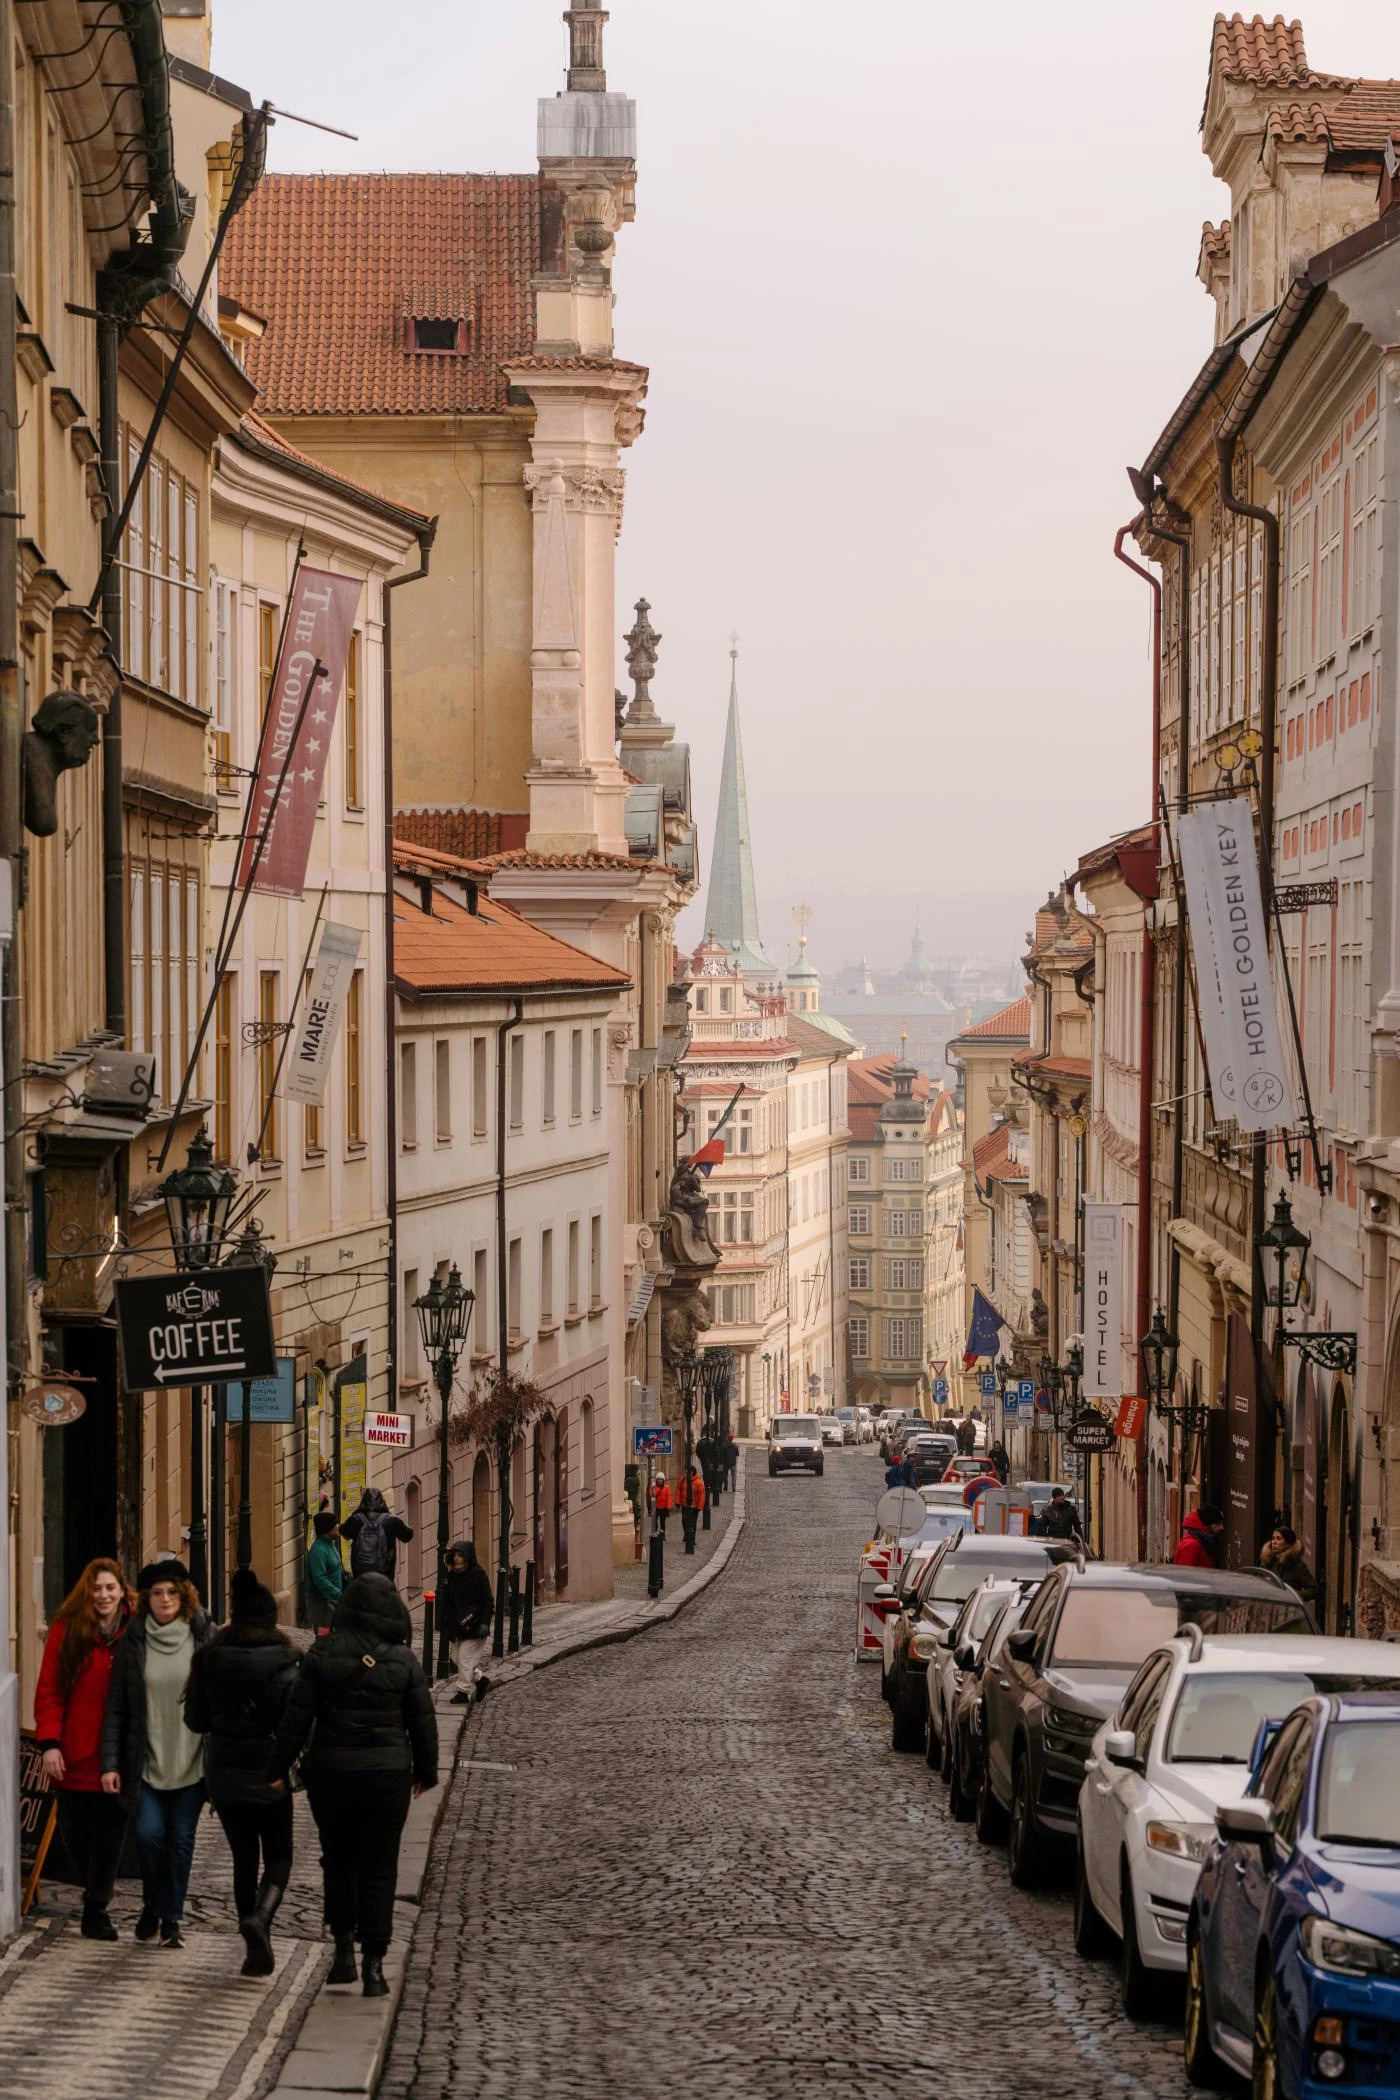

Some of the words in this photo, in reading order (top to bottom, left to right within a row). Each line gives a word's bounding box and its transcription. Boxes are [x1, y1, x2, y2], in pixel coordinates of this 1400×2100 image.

[295, 586, 333, 642] THE
[271, 650, 317, 760] GOLDEN
[1217, 823, 1239, 867] KEY
[1224, 874, 1255, 976] GOLDEN
[299, 998, 330, 1062] MARE
[1240, 981, 1267, 1056] HOTEL
[149, 1318, 245, 1361] COFFEE
[1097, 1270, 1108, 1386] HOSTEL
[985, 1378, 993, 1388] P
[1022, 1384, 1032, 1397] P
[376, 1414, 399, 1428] MINI
[1077, 1426, 1106, 1435] SUPER
[1122, 1399, 1139, 1434] change
[368, 1429, 407, 1445] MARKET
[1073, 1436, 1110, 1445] MARKET
[20, 1796, 42, 1833] OU
